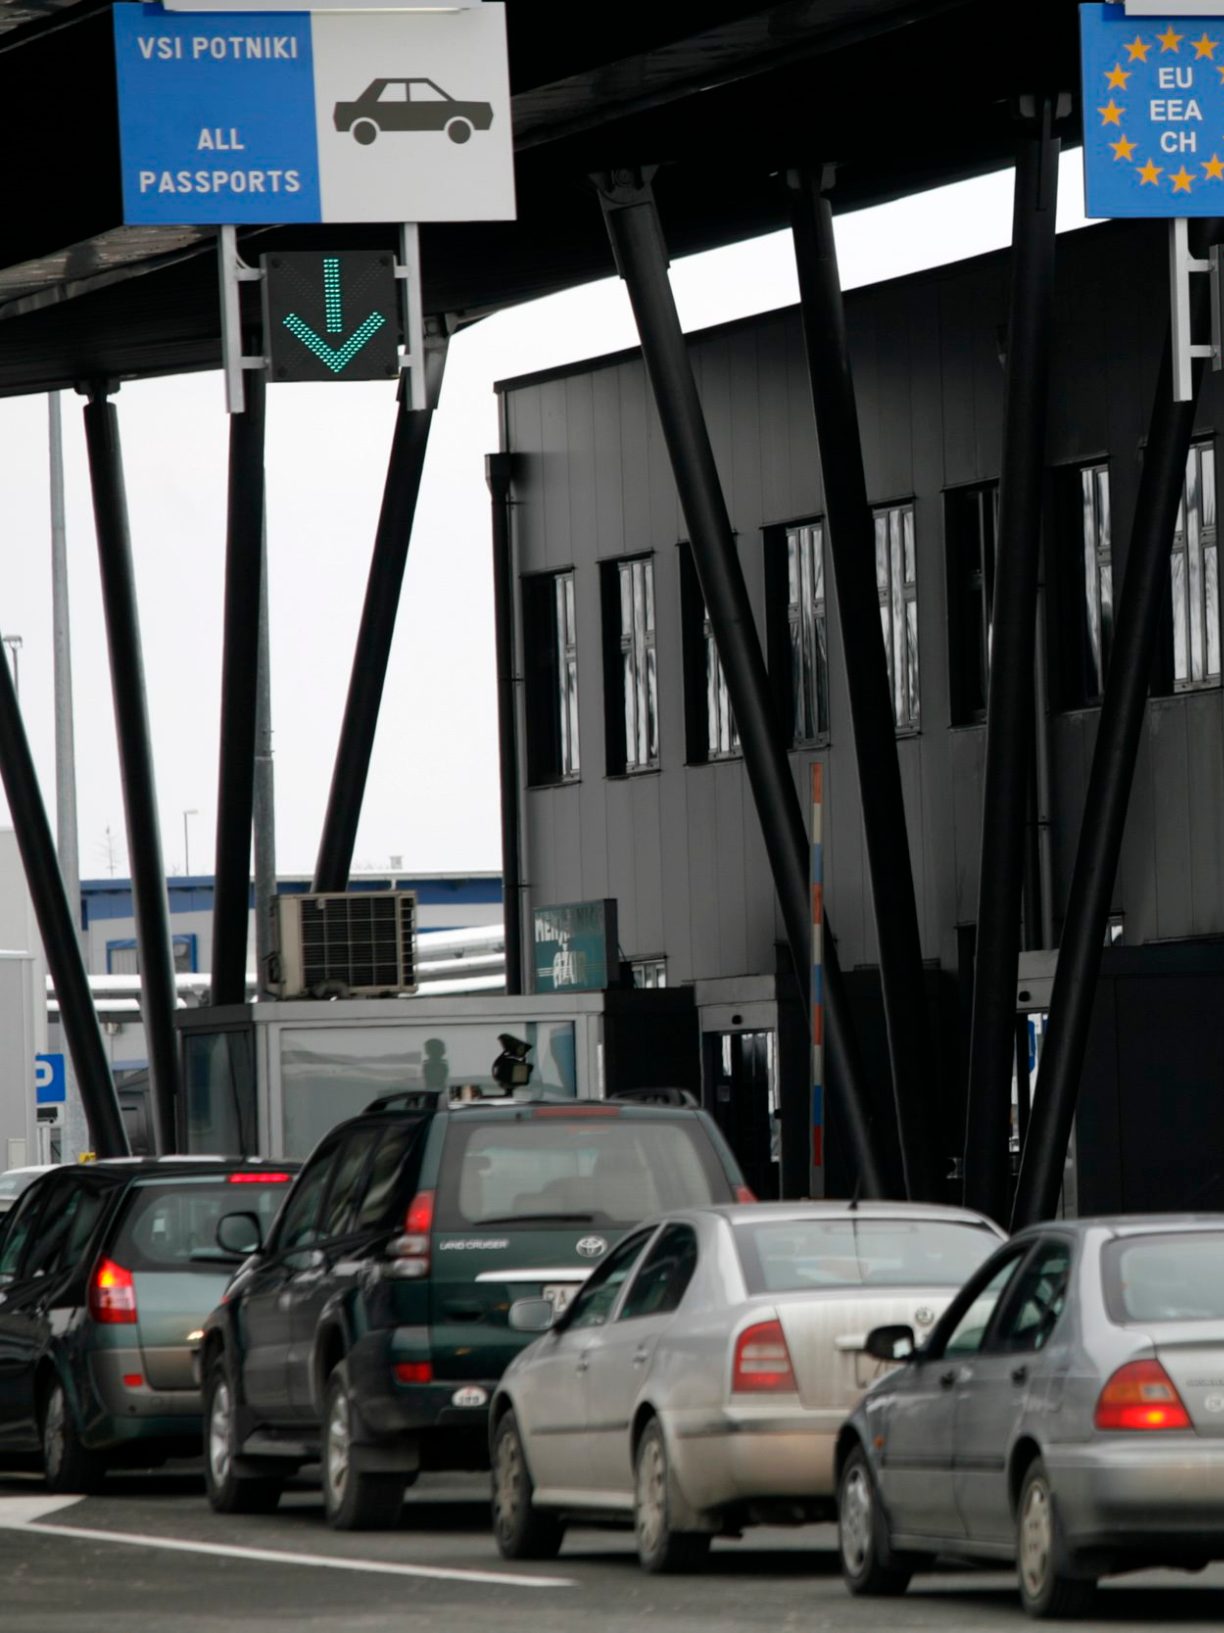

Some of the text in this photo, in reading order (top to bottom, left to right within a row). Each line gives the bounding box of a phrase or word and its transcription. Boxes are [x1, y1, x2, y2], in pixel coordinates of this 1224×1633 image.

[137, 36, 298, 60] VSI POTNIKI
[1158, 66, 1194, 90] EU
[1149, 99, 1204, 122] EEA
[196, 127, 246, 151] ALL
[1160, 130, 1198, 153] CH
[138, 170, 301, 194] PASSPORTS
